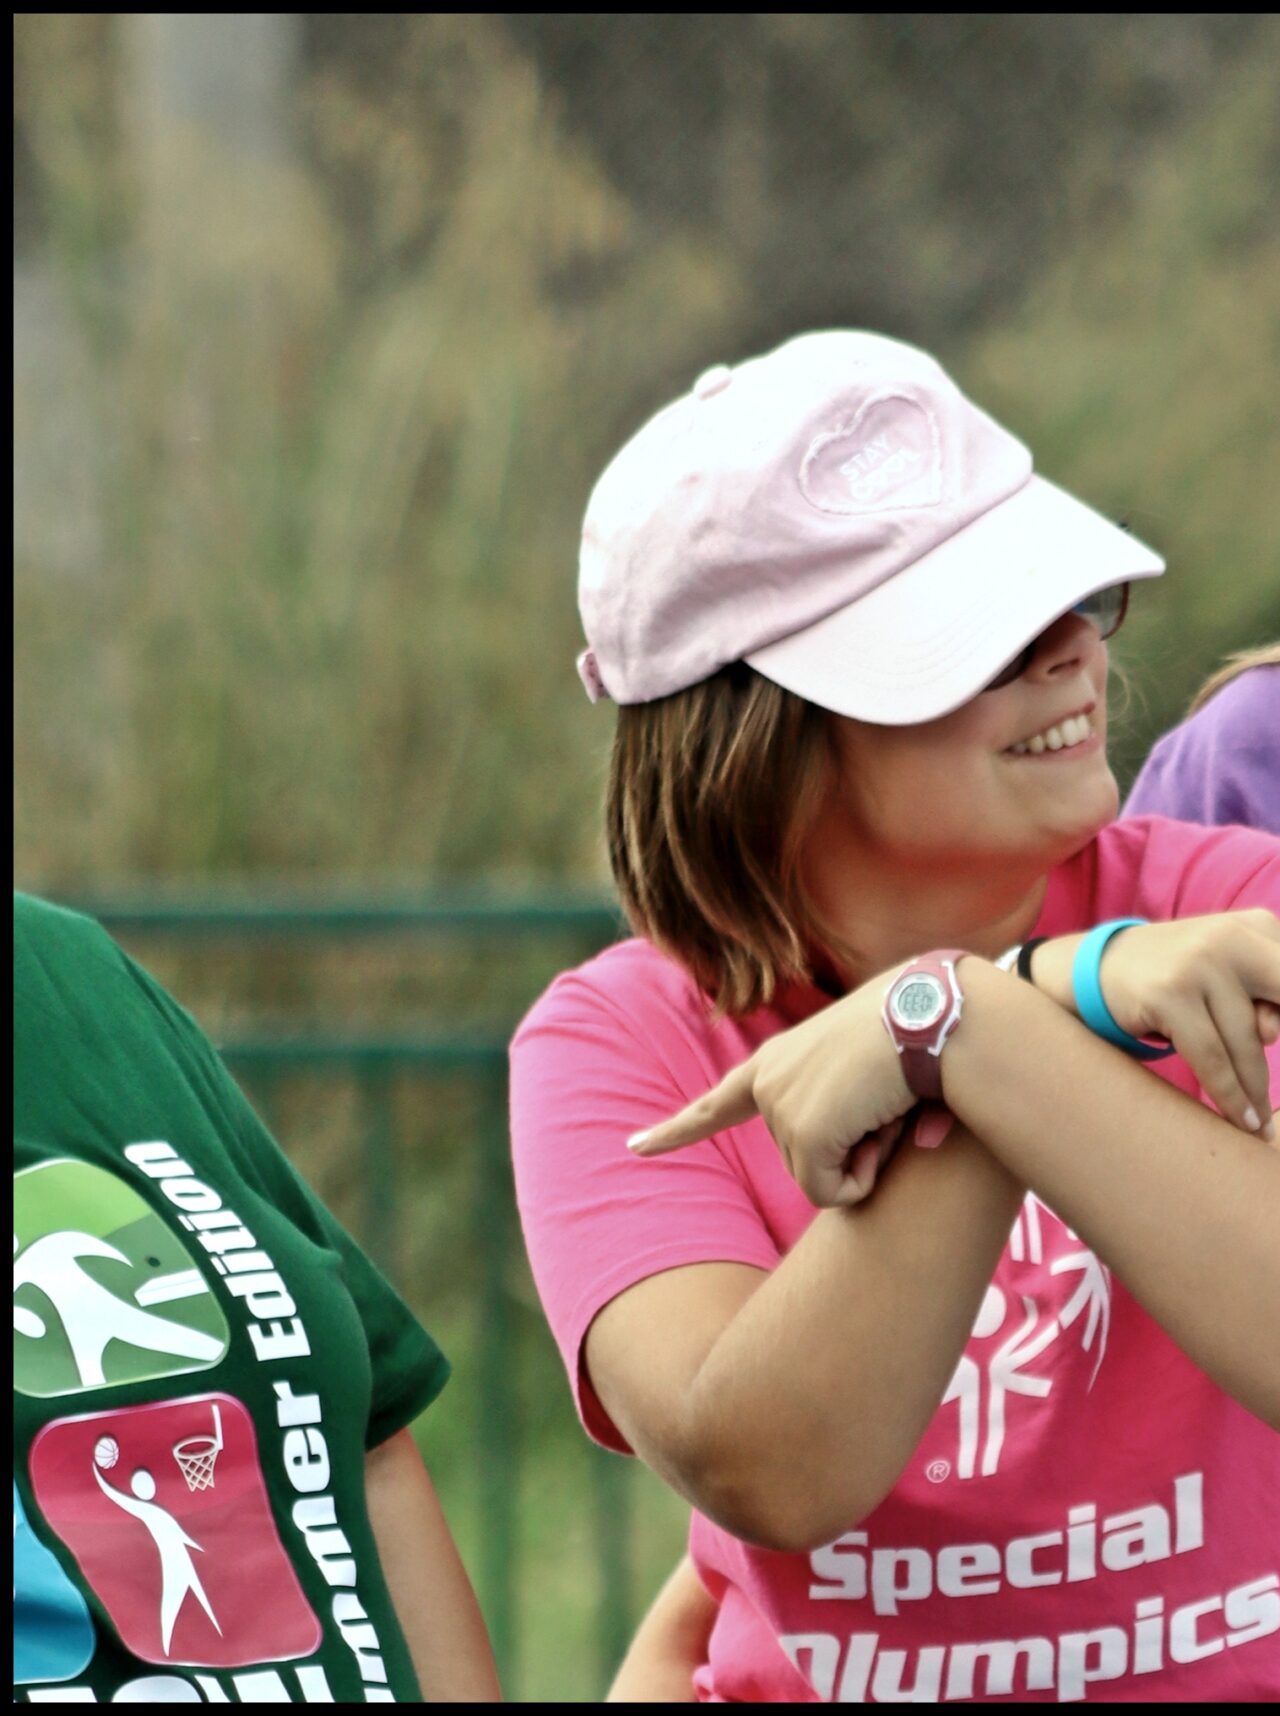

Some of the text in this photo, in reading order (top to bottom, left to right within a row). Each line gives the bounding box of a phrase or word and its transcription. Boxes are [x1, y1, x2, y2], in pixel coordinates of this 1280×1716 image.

[839, 432, 890, 481] STAY
[124, 1140, 398, 1703] mmer Edition
[808, 1471, 1204, 1617] Special
